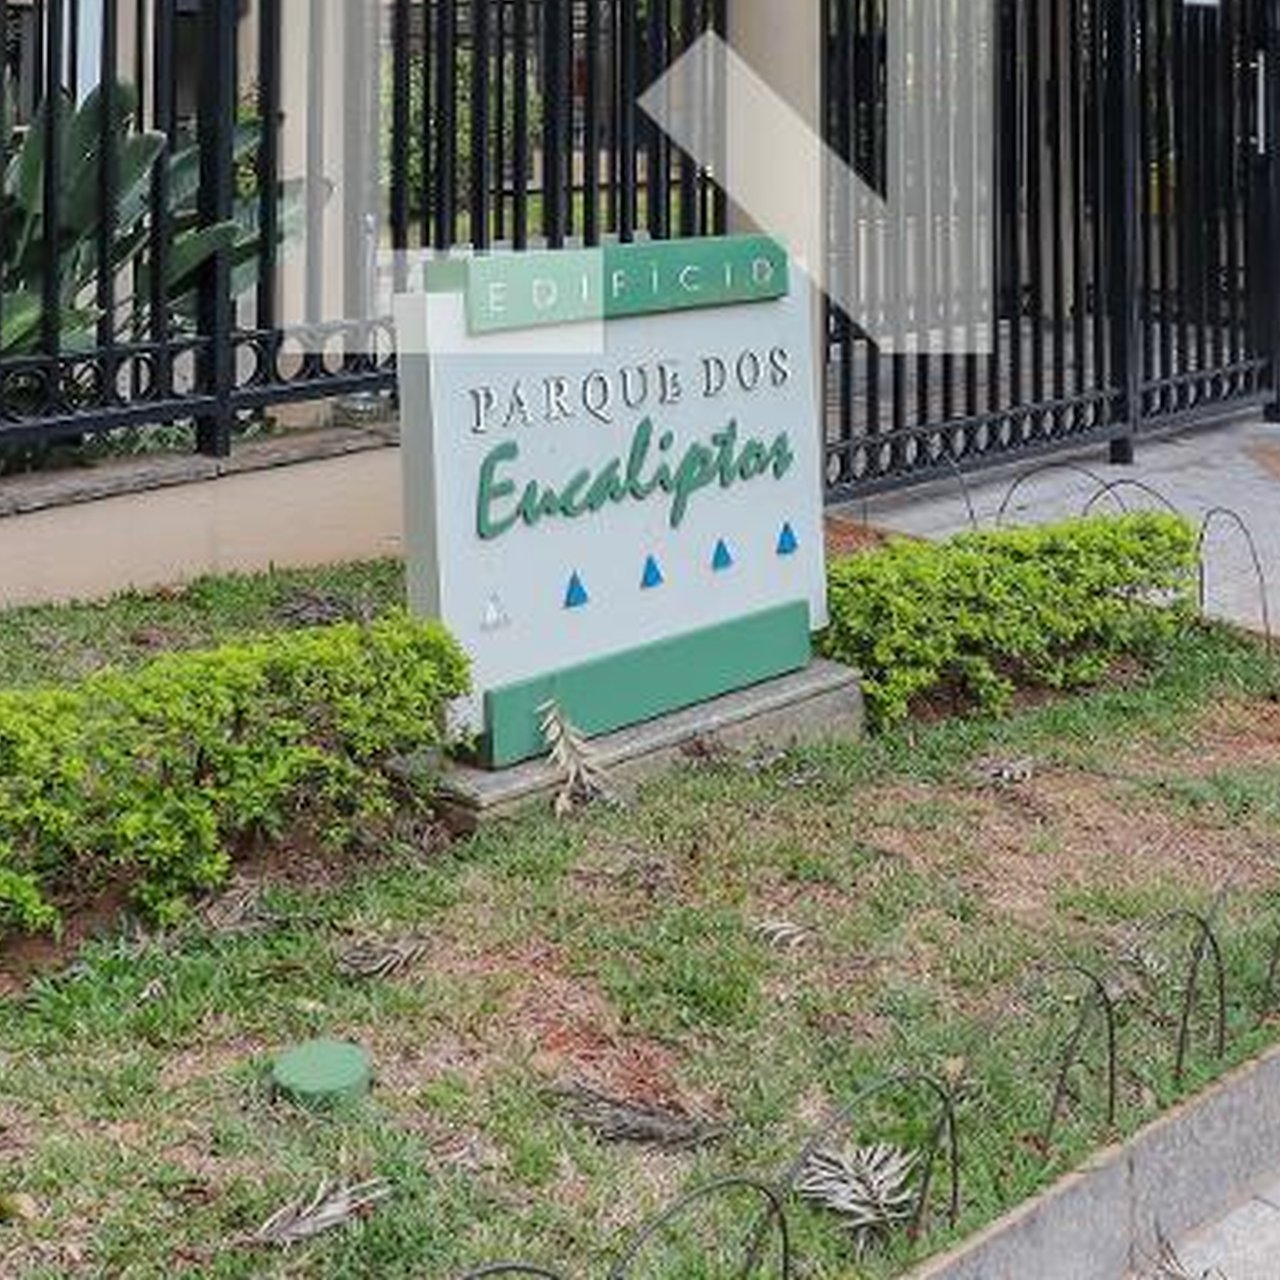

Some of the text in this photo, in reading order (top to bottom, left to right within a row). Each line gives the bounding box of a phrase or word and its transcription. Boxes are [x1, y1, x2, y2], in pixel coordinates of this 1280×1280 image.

[470, 346, 792, 434] PARQUE DOS
[476, 416, 795, 540] Eucaliptos
